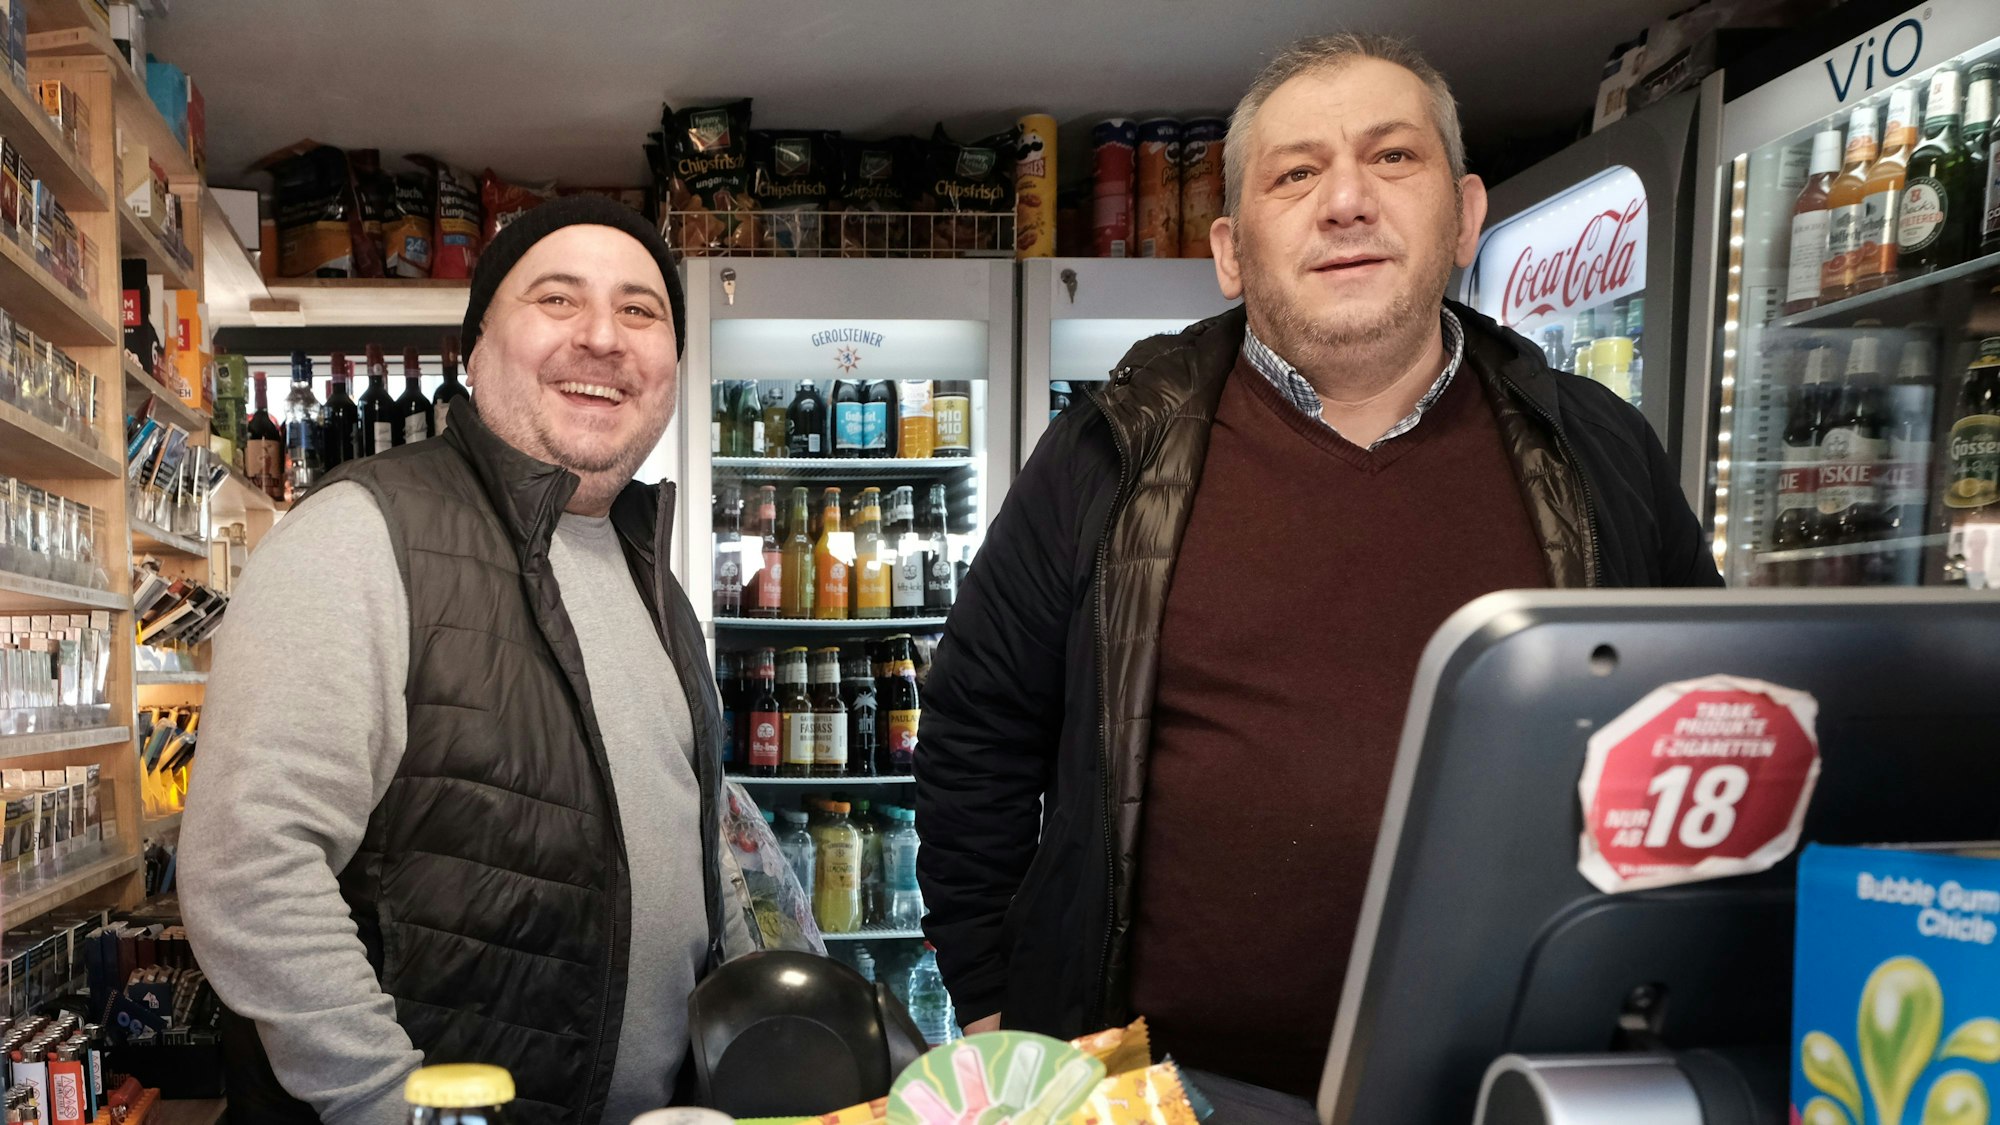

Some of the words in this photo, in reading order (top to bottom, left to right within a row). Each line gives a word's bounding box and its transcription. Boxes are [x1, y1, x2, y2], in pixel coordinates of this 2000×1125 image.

[1824, 18, 1923, 103] ViO
[678, 153, 745, 175] Chipsfrisch
[695, 176, 739, 189] ungarch
[758, 181, 826, 199] Chipsfrisch
[934, 180, 1005, 201] Chipsfrisch
[811, 328, 883, 348] GEROLSTEINER
[937, 410, 961, 422] MIO
[937, 422, 961, 434] MIO
[1817, 465, 1871, 483] YSKIE
[1674, 718, 1768, 736] PRODUKTE
[1652, 738, 1776, 757] E-ZIGARETTEN
[1643, 764, 1749, 849] 18
[1604, 809, 1651, 829] NUR
[1611, 828, 1644, 847] AB
[1857, 871, 1937, 907] Bubble
[1938, 880, 2000, 914] Gum
[1917, 907, 1998, 944] Chicle
